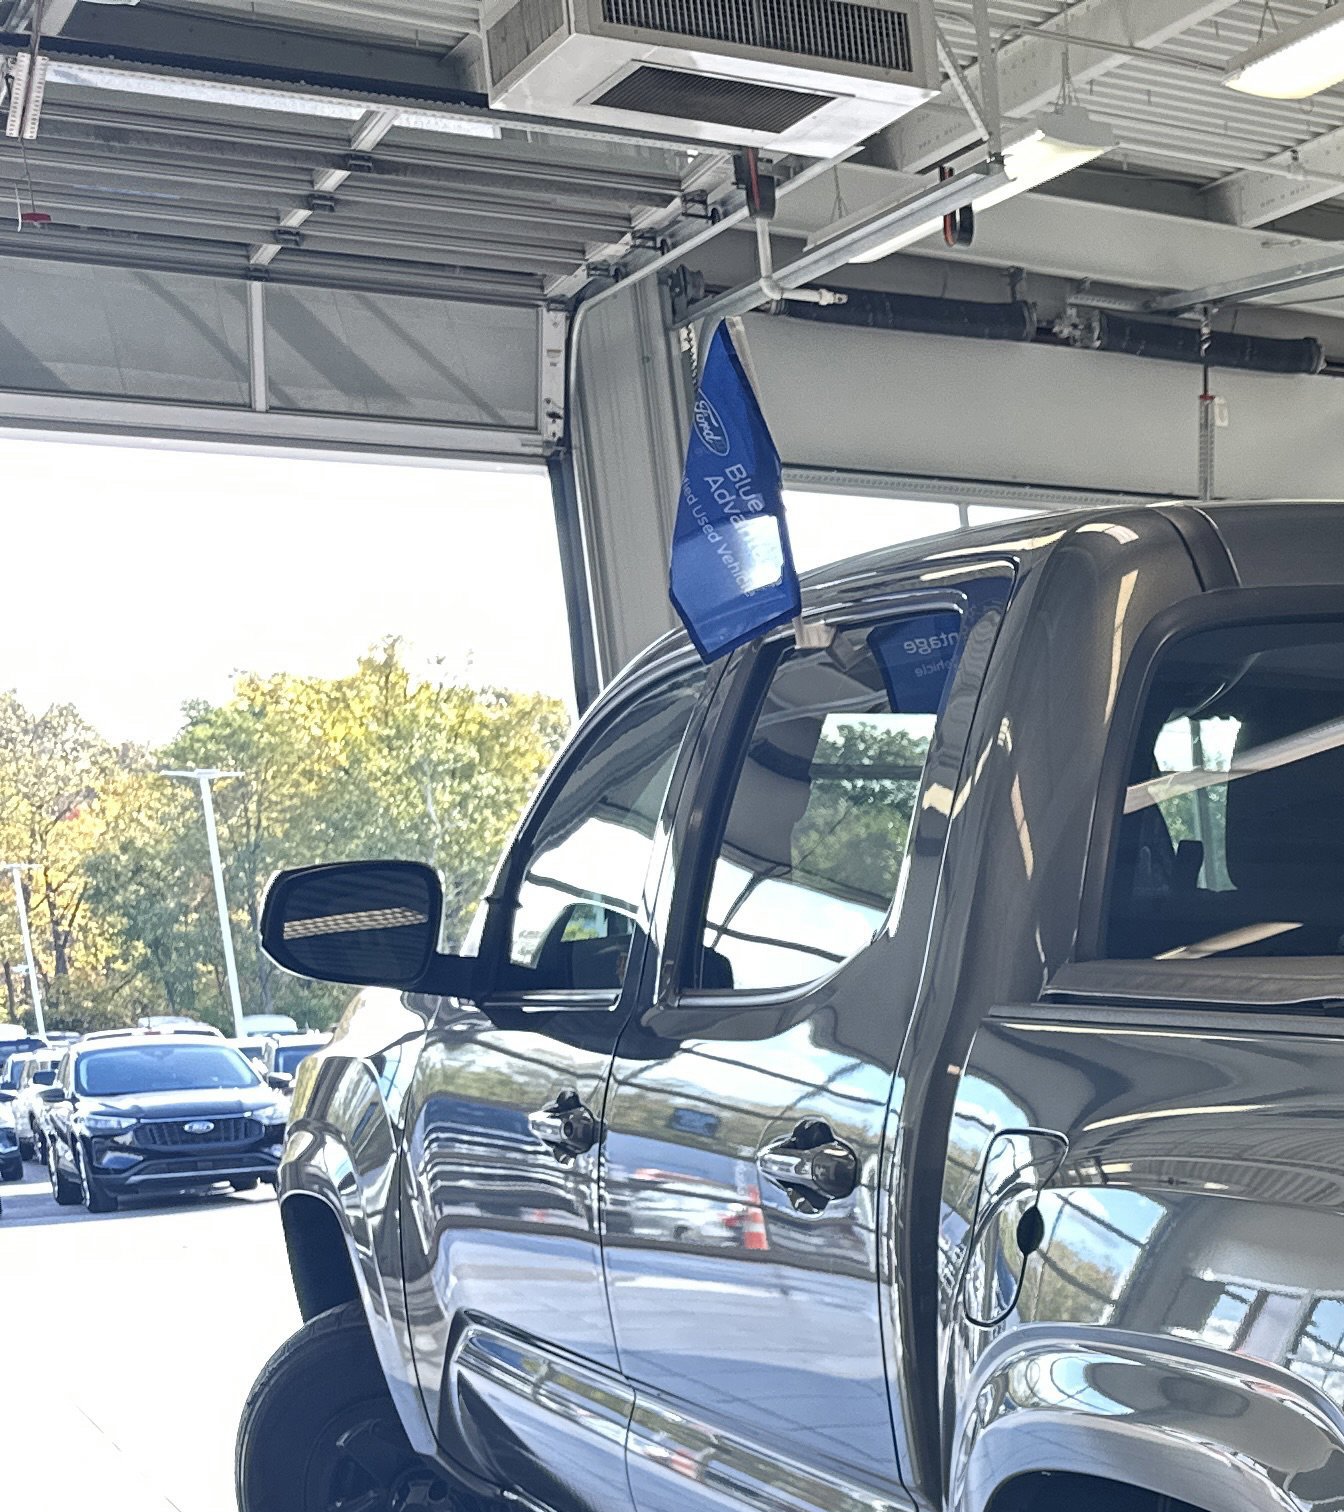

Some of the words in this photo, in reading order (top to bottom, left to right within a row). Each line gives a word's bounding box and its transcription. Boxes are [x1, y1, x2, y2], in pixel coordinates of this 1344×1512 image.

[693, 400, 722, 444] Ford
[725, 462, 765, 514] Blue
[692, 503, 724, 545] Used
